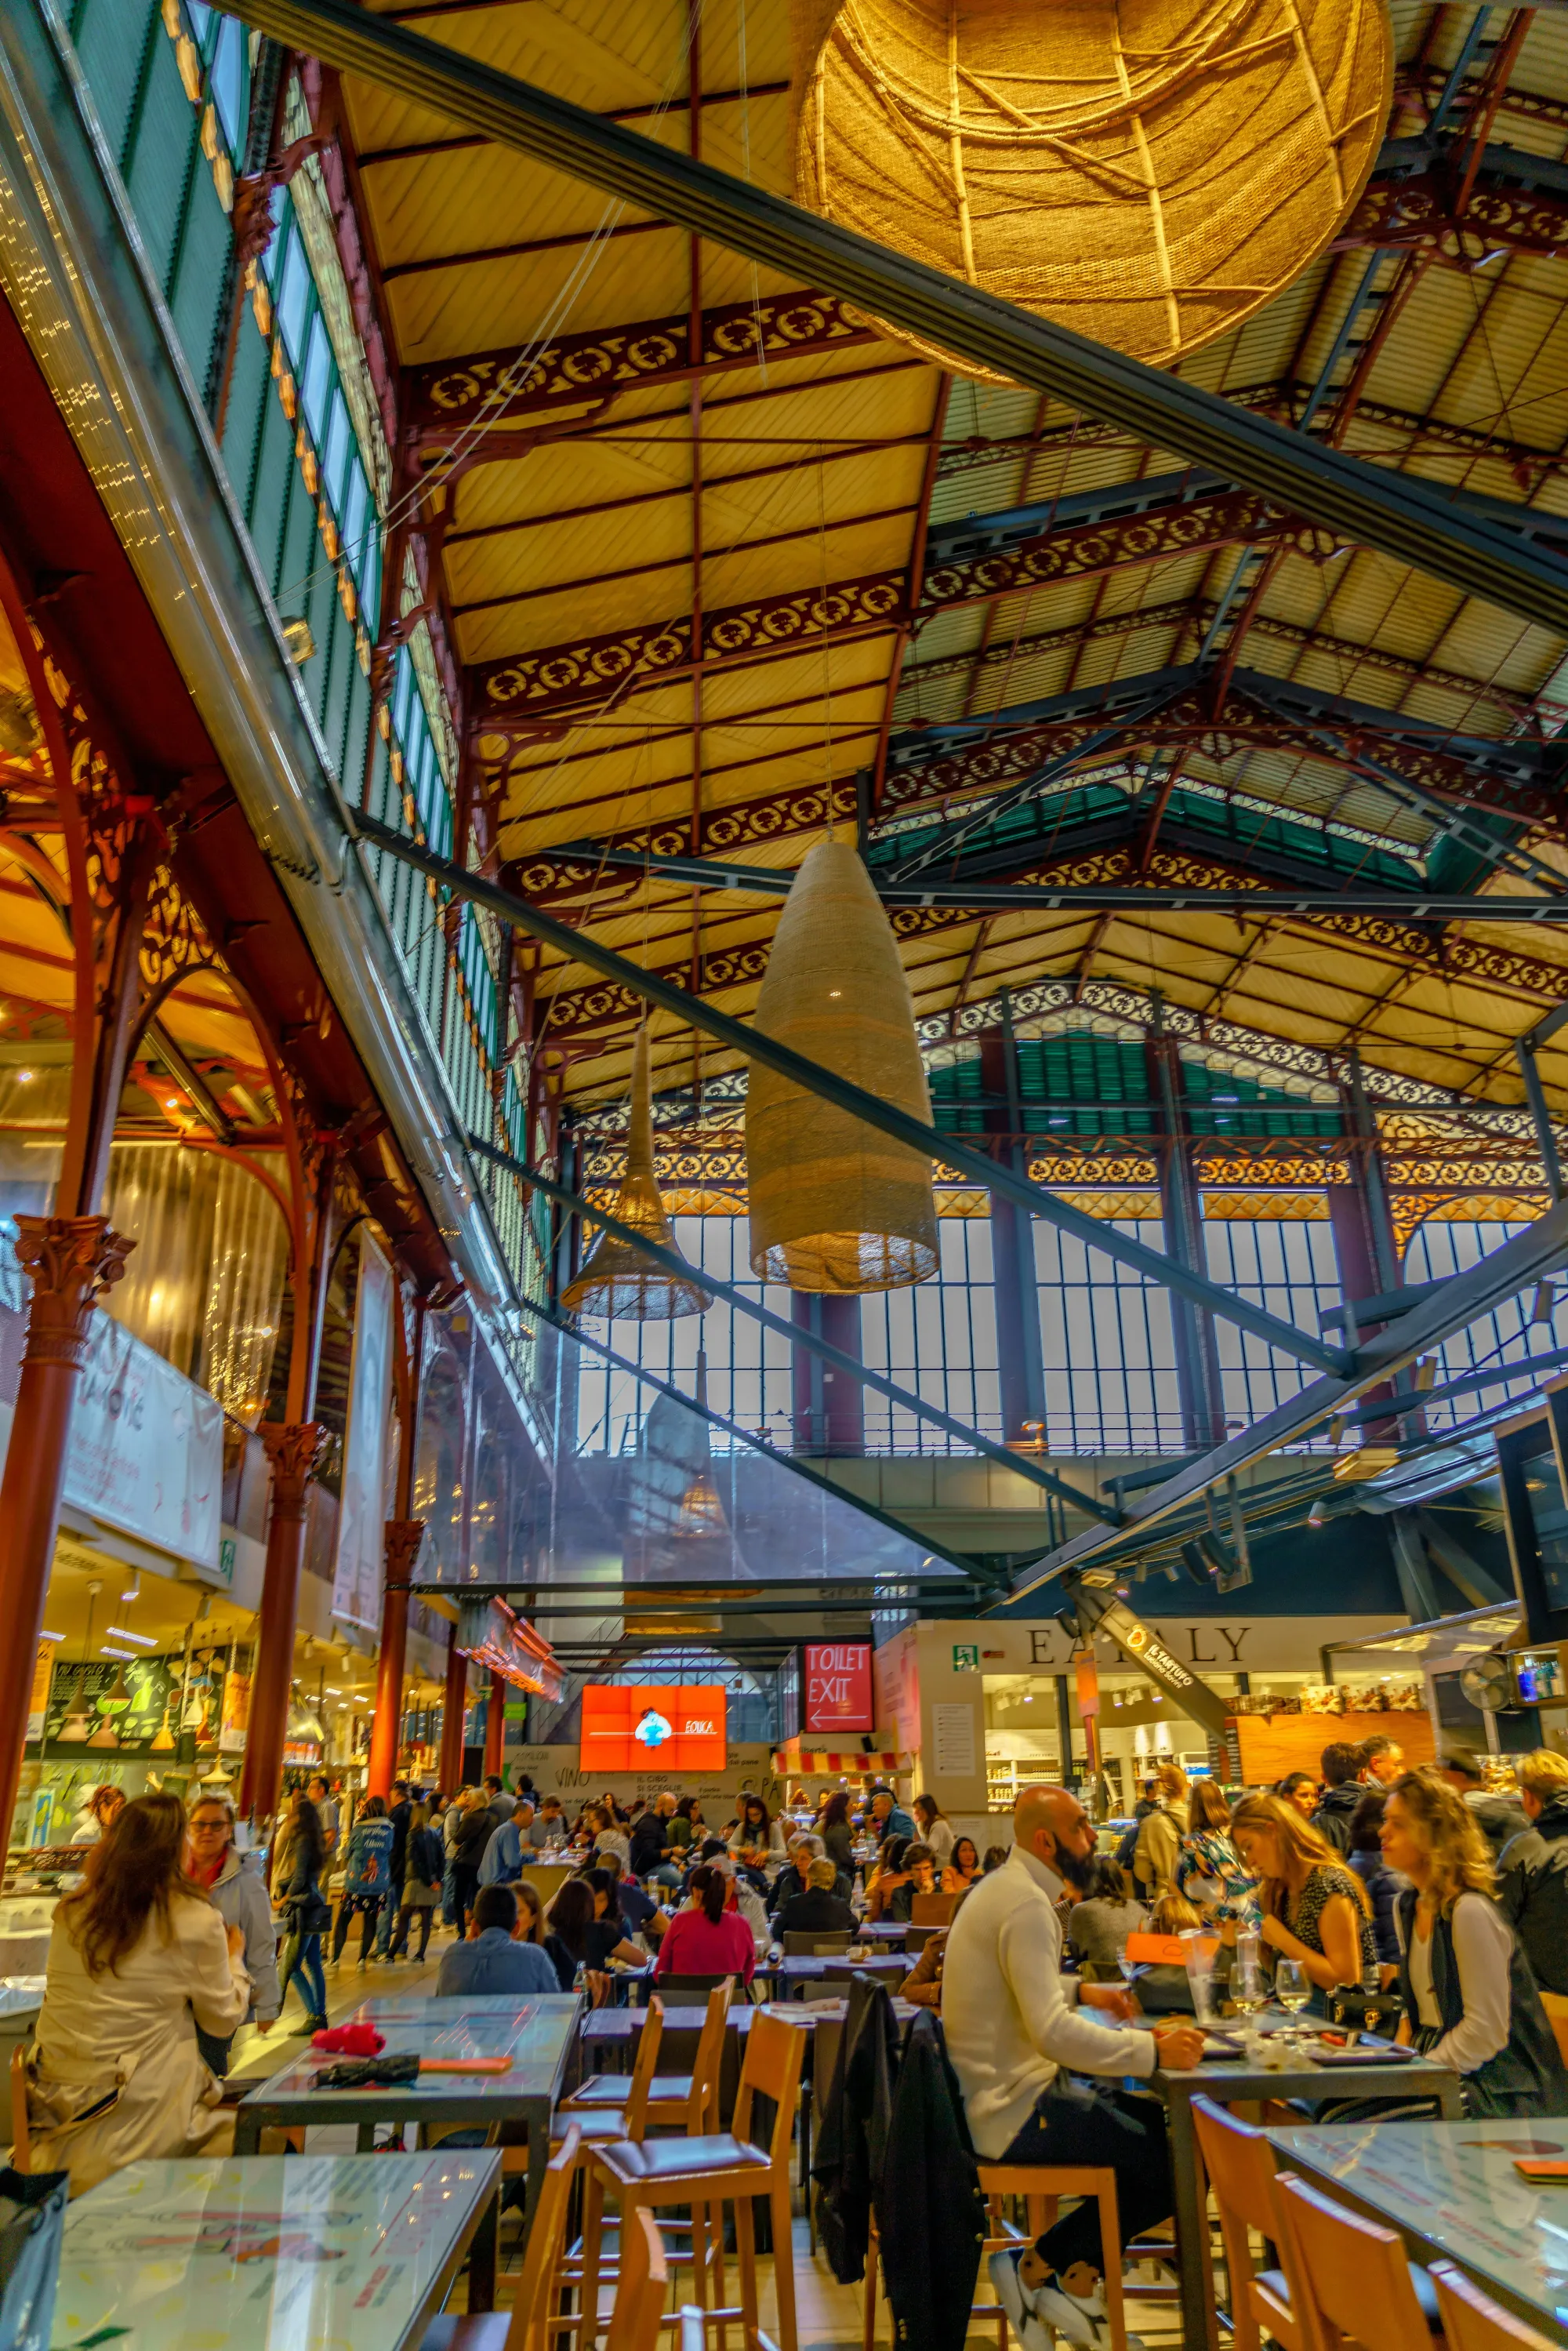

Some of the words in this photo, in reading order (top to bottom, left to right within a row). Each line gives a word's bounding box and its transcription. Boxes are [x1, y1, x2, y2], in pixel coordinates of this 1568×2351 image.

[808, 1646, 869, 1671] TOILET
[1025, 1627, 1252, 1664] EALY
[1143, 1651, 1168, 1674] Luciano
[1148, 1644, 1160, 1656] IL
[1156, 1650, 1195, 1687] TARTUFO
[808, 1676, 853, 1703] EXIT
[554, 1766, 591, 1789] VINO
